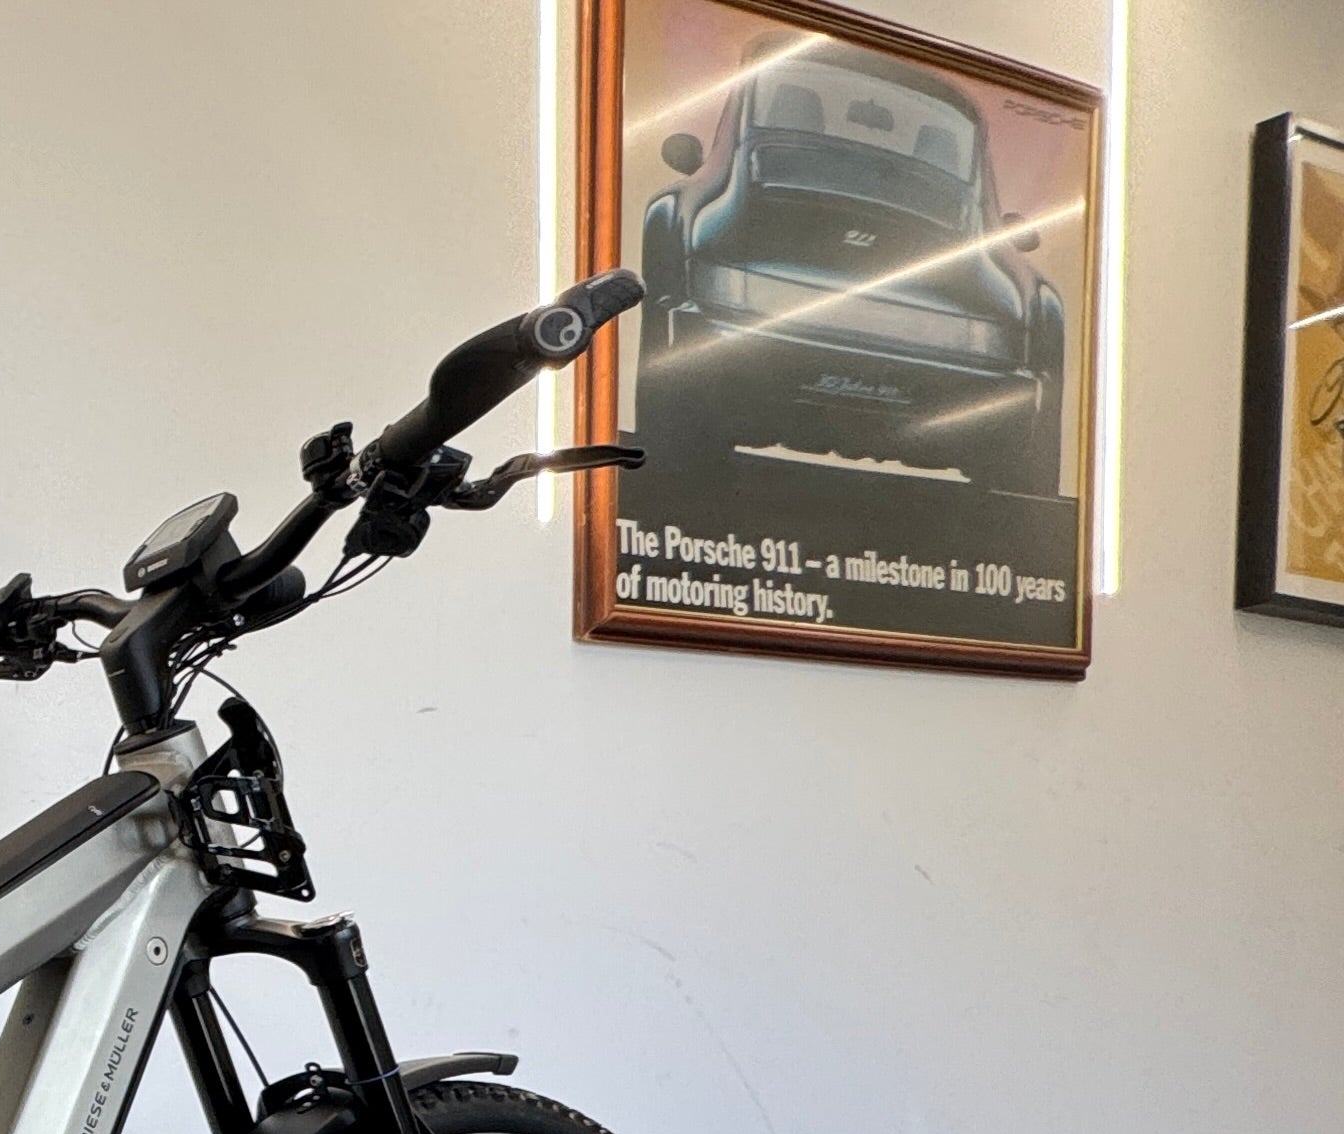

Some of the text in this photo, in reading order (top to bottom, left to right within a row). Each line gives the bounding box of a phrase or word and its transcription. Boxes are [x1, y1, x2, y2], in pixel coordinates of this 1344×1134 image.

[615, 563, 833, 623] of motoring history.
[616, 518, 659, 557] The
[664, 525, 756, 569] Porsche
[761, 538, 803, 575] 911
[826, 554, 840, 579] a
[845, 550, 946, 590] milestone
[950, 559, 969, 592] in
[974, 563, 1011, 597] 100
[1015, 574, 1066, 604] years
[103, 1007, 139, 1081] MÜLLER
